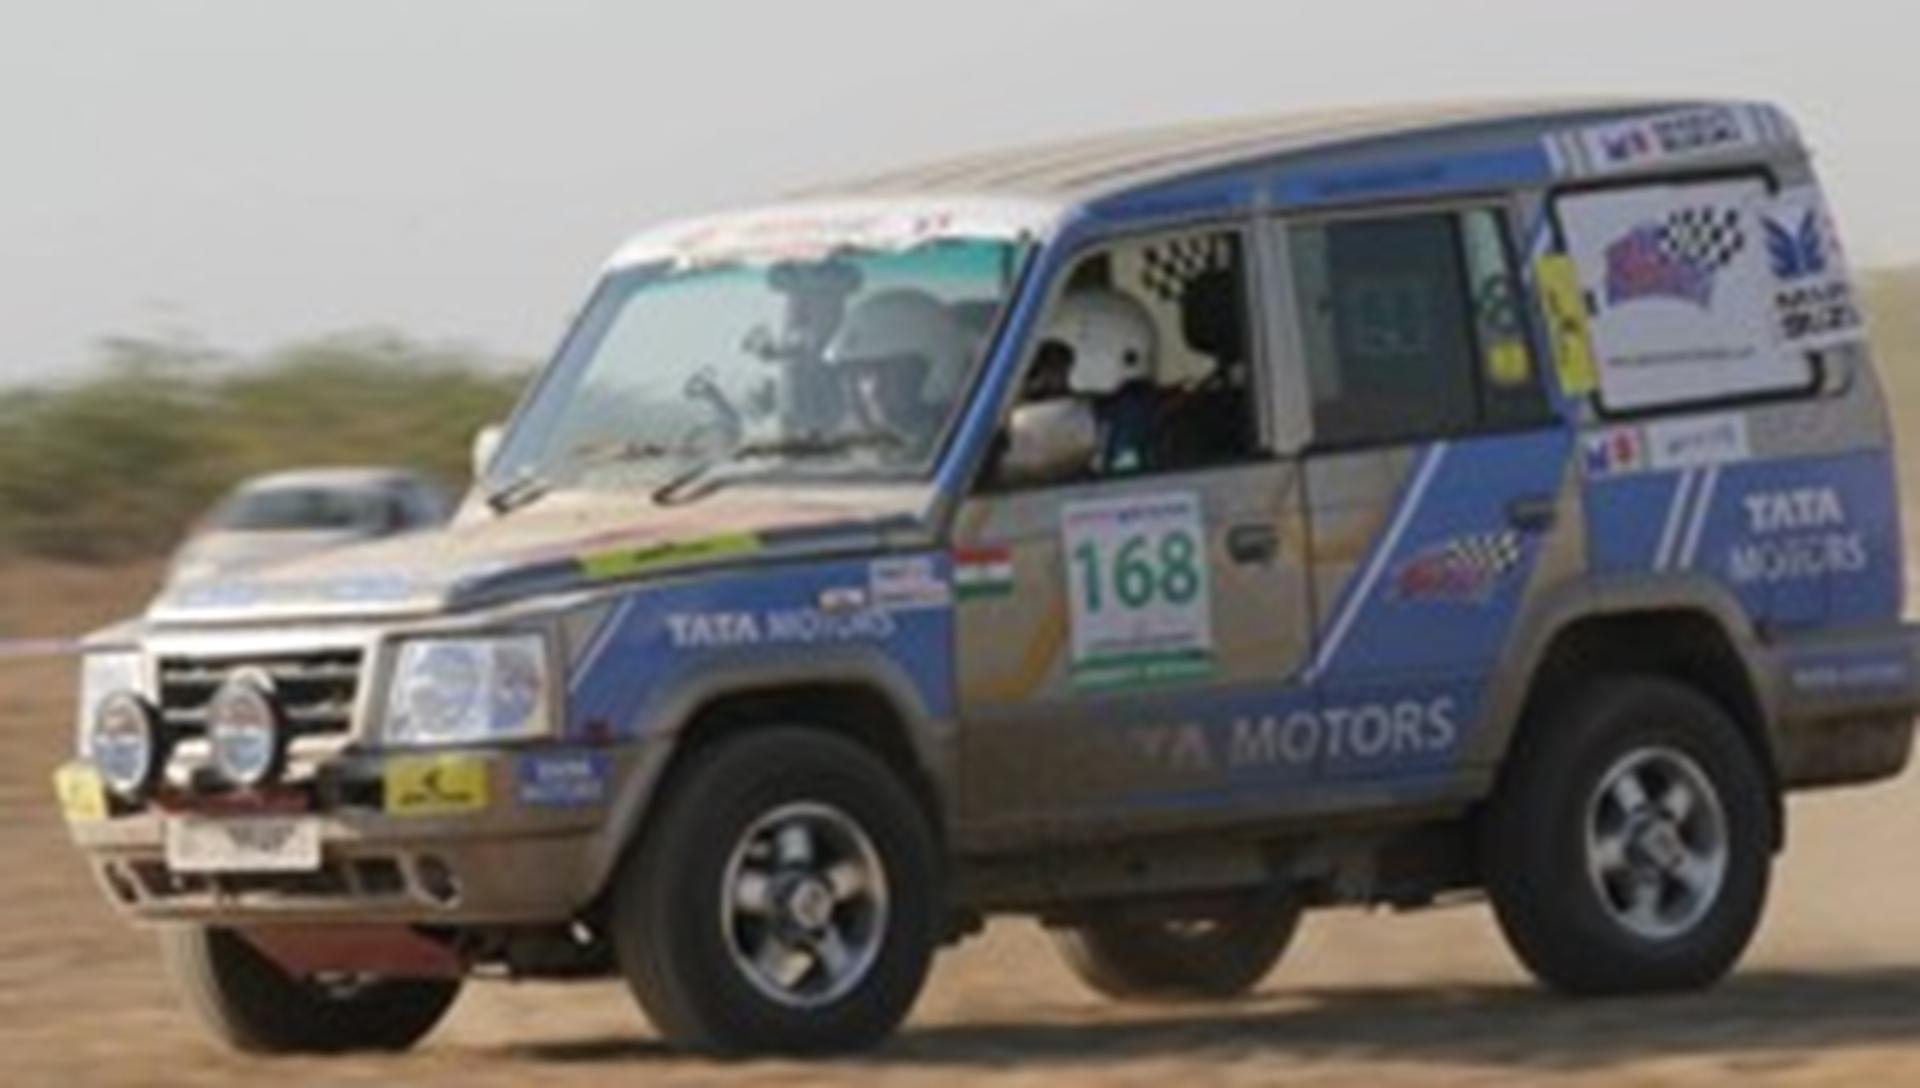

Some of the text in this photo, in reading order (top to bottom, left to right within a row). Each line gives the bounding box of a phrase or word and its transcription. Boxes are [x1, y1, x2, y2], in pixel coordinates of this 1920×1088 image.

[1744, 488, 1844, 532] TATA
[1075, 530, 1200, 613] 168
[1729, 533, 1866, 580] MOTORS
[666, 611, 760, 647] TATA
[1230, 697, 1456, 766] MOTORS
